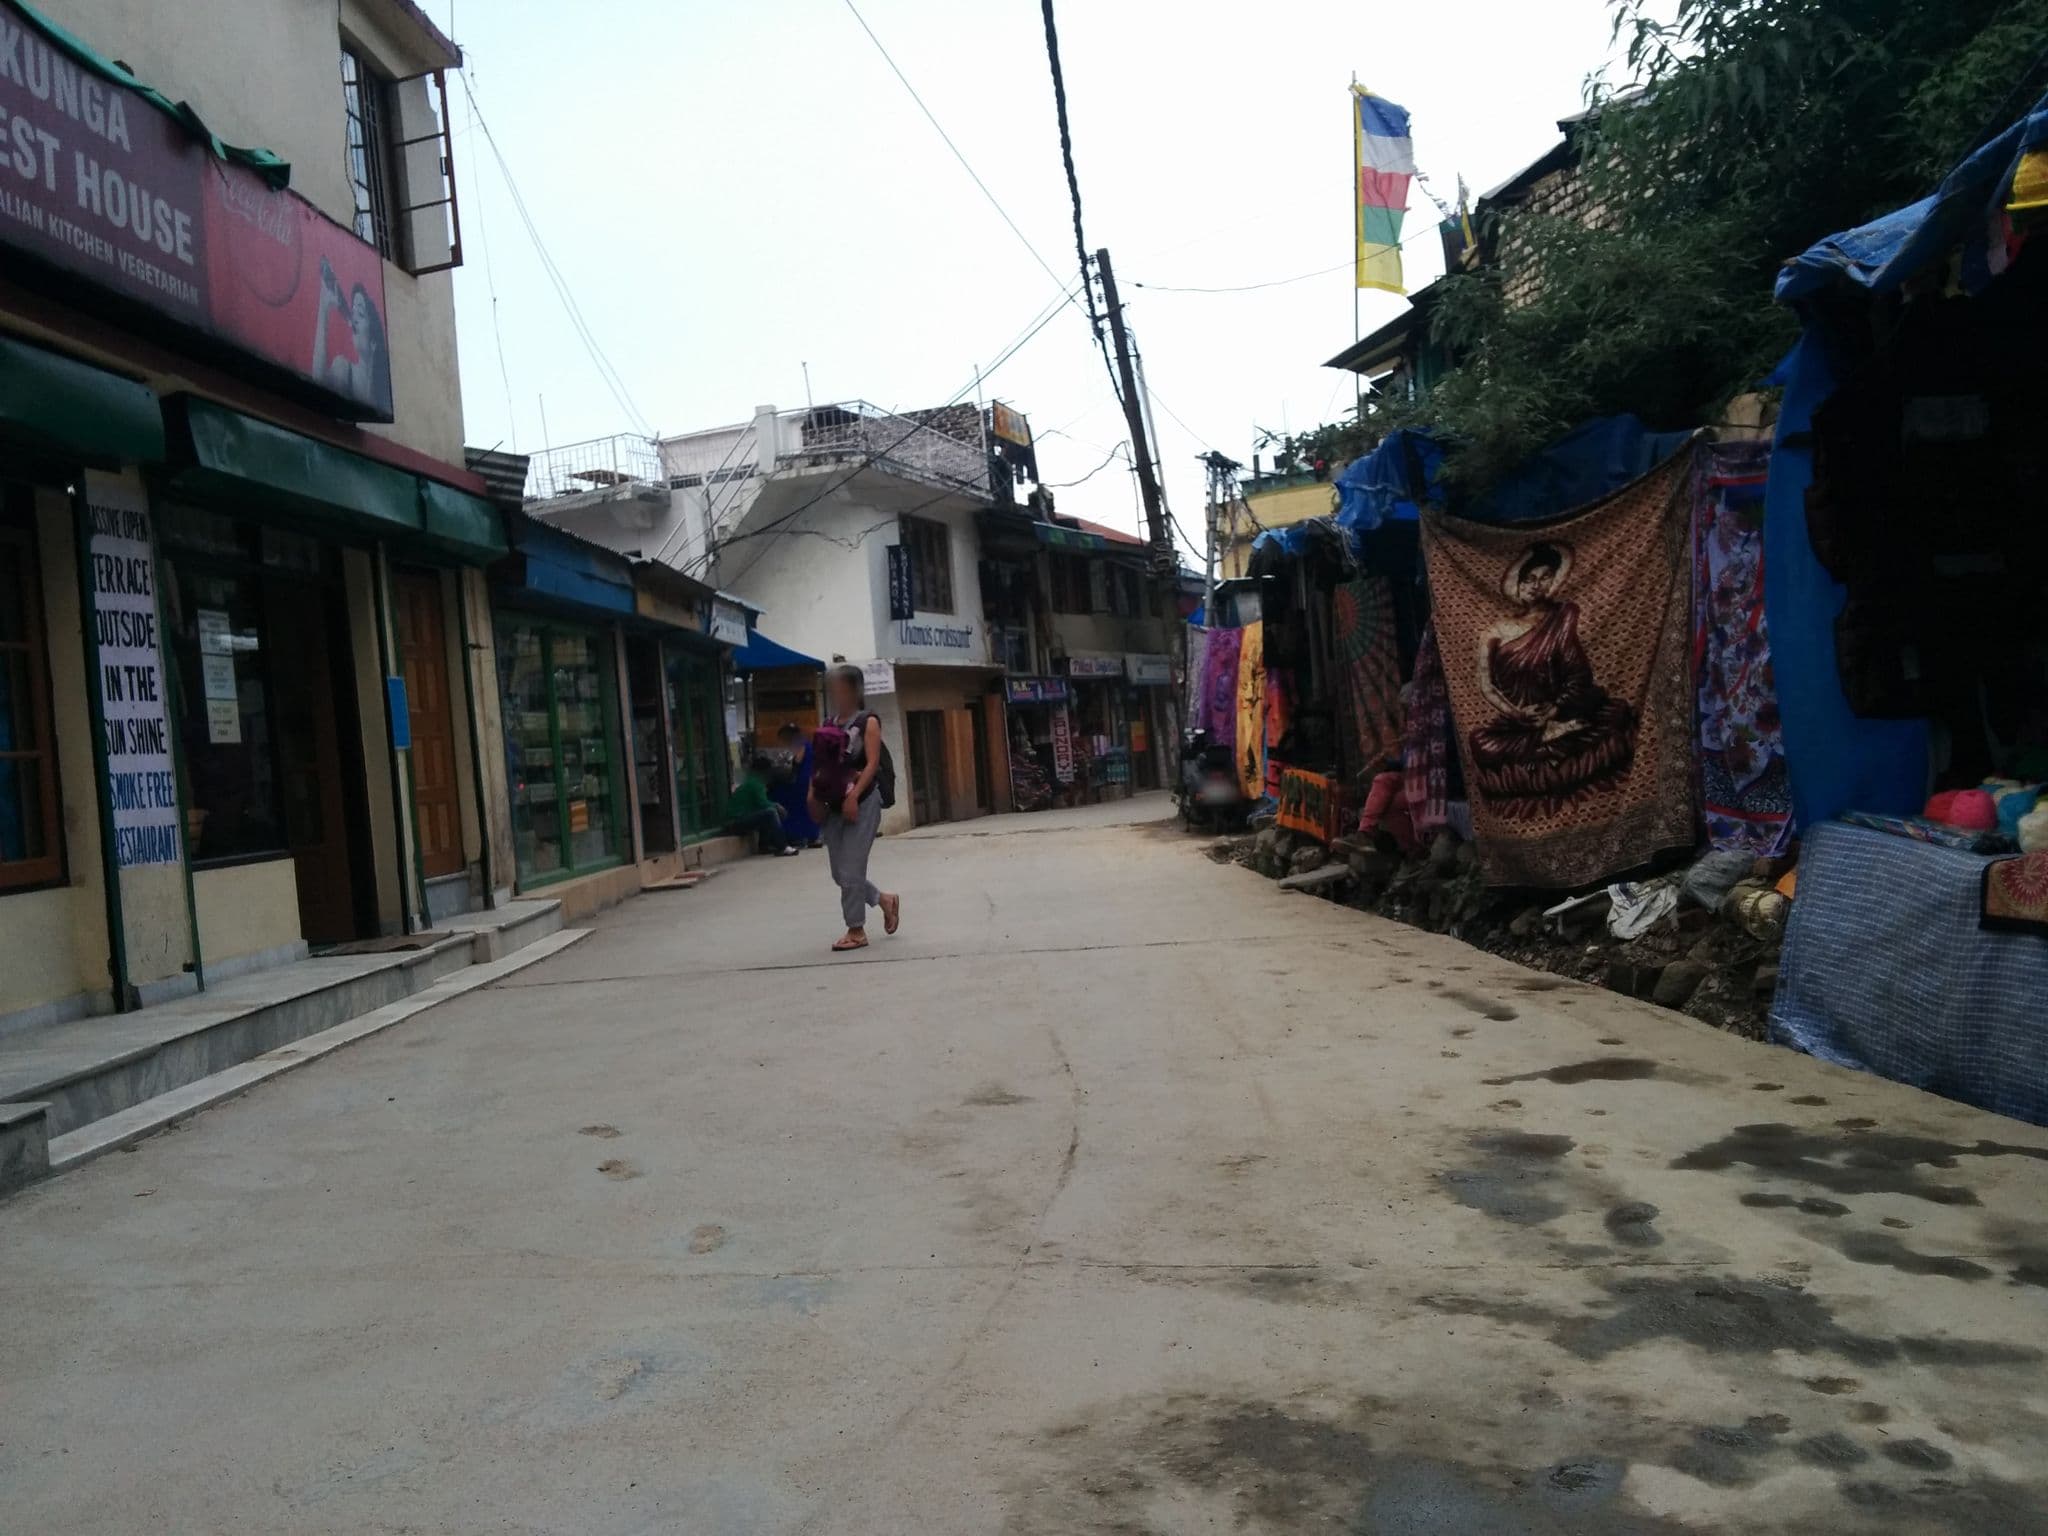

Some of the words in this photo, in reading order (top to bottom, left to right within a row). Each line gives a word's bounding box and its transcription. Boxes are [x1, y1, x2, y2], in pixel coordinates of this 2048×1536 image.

[0, 17, 131, 152] KUNGA
[75, 150, 194, 266] HOUSE
[48, 214, 114, 266] KITCHEN
[117, 250, 199, 305] VEGETARIAN
[122, 511, 147, 542] OPEN
[91, 553, 151, 596] TERRACE
[96, 610, 156, 649] OUTSIDE
[105, 666, 123, 702] IN
[125, 666, 158, 702] THE
[104, 718, 126, 756] SUN
[127, 717, 167, 755] SHINE
[109, 772, 146, 811] SMOKE
[147, 771, 175, 809] FREE
[115, 825, 178, 866] RESTAURANT
